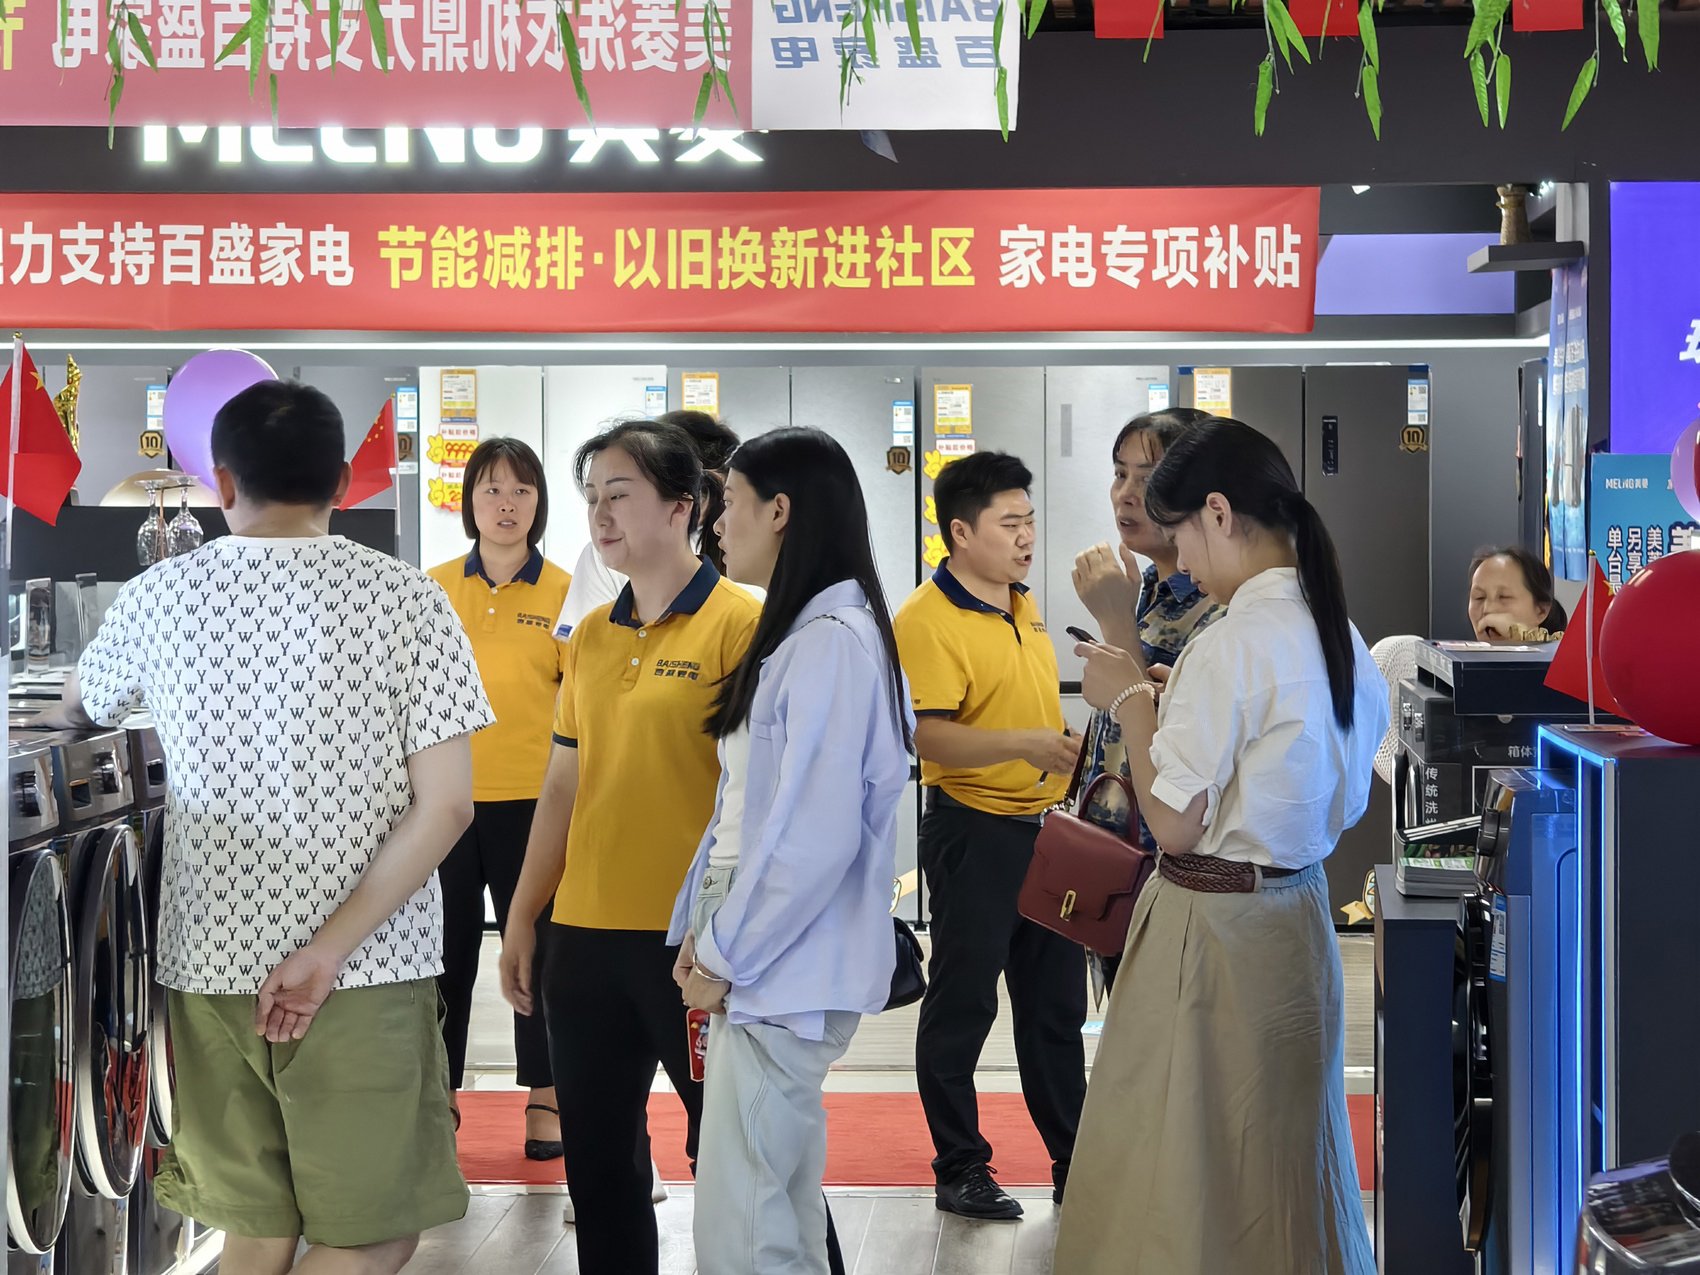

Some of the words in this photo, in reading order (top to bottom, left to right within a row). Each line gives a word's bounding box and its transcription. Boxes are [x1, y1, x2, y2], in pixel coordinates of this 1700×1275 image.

[0, 222, 354, 287] 力支持百盛家电
[379, 225, 975, 290] 节能减排·以旧换新进社区
[999, 223, 1302, 289] 家电专项补贴
[145, 436, 158, 448] 10
[1407, 430, 1421, 443] 10
[292, 548, 302, 560] Y
[232, 570, 242, 584] Y
[261, 571, 270, 584] Y
[288, 570, 298, 582] Y
[374, 569, 384, 580] Y
[201, 592, 210, 606] Y
[257, 594, 267, 607] Y
[285, 592, 295, 605] Y
[370, 591, 380, 604] Y
[185, 604, 199, 616] W
[269, 606, 283, 617] W
[353, 602, 368, 614] W
[198, 617, 208, 631] Y
[226, 619, 236, 632] Y
[255, 619, 264, 632] Y
[282, 617, 292, 630] Y
[310, 614, 319, 627] Y
[338, 613, 348, 627] Y
[367, 616, 376, 629] Y
[266, 631, 280, 642] W
[294, 628, 308, 640] W
[321, 626, 336, 637] W
[350, 627, 364, 639] W
[197, 644, 206, 657] Y
[224, 644, 234, 658] Y
[253, 644, 262, 658] Y
[335, 638, 346, 653] Y
[364, 641, 374, 655] Y
[265, 656, 279, 668] W
[292, 654, 306, 666] W
[319, 652, 334, 664] W
[348, 653, 362, 665] W
[224, 670, 234, 684] Y
[279, 668, 288, 682] Y
[306, 666, 316, 681] Y
[334, 666, 344, 680] Y
[362, 667, 372, 681] Y
[209, 684, 224, 695] W
[237, 683, 251, 694] W
[264, 682, 278, 694] W
[290, 681, 305, 692] W
[318, 680, 334, 692] W
[347, 680, 362, 692] W
[375, 681, 388, 694] W
[224, 696, 234, 710] Y
[278, 694, 287, 709] Y
[305, 693, 315, 708] Y
[334, 693, 344, 707] Y
[362, 693, 372, 707] Y
[264, 709, 277, 720] W
[290, 708, 304, 719] W
[318, 707, 334, 718] W
[347, 706, 361, 718] W
[198, 722, 208, 736] Y
[226, 722, 235, 736] Y
[305, 720, 316, 734] Y
[239, 735, 253, 747] W
[319, 734, 334, 746] W
[199, 749, 209, 762] Y
[306, 747, 316, 760] Y
[335, 746, 345, 760] Y
[240, 761, 254, 773] W
[292, 760, 306, 772] W
[320, 760, 335, 772] W
[349, 759, 363, 770] W
[228, 774, 237, 788] Y
[255, 773, 264, 787] Y
[308, 772, 317, 786] Y
[336, 772, 346, 786] Y
[212, 788, 227, 799] W
[240, 787, 254, 798] W
[292, 786, 308, 798] W
[321, 786, 336, 798] W
[349, 785, 363, 796] W
[227, 800, 238, 814] Y
[255, 799, 264, 813] Y
[308, 798, 318, 812] Y
[336, 798, 346, 813] Y
[213, 814, 226, 825] W
[241, 813, 255, 824] W
[267, 812, 282, 823] W
[294, 812, 308, 824] W
[348, 810, 363, 822] W
[227, 826, 238, 840] Y
[308, 824, 318, 839] Y
[336, 824, 346, 838] Y
[364, 822, 373, 836] Y
[214, 839, 227, 851] W
[240, 838, 255, 850] W
[268, 838, 282, 849] W
[295, 838, 308, 849] W
[322, 838, 336, 849] W
[350, 836, 363, 849] W
[228, 851, 237, 865] Y
[255, 850, 265, 864] Y
[282, 850, 292, 864] Y
[214, 865, 227, 876] W
[240, 864, 255, 876] W
[268, 863, 282, 874] W
[322, 864, 336, 875] W
[228, 877, 238, 890] Y
[255, 876, 265, 890] Y
[283, 875, 292, 888] Y
[310, 876, 319, 890] Y
[214, 890, 228, 902] W
[240, 889, 255, 901] W
[268, 888, 282, 900] W
[295, 888, 310, 900] W
[228, 902, 238, 916] Y
[255, 901, 265, 915] Y
[282, 900, 292, 914] Y
[310, 901, 320, 915] Y
[240, 914, 255, 926] W
[267, 914, 282, 926] W
[228, 927, 238, 941] Y
[254, 926, 264, 940] Y
[281, 926, 291, 940] Y
[240, 940, 254, 951] W
[266, 939, 280, 950] W
[227, 952, 237, 966] Y
[253, 952, 263, 965] Y
[239, 964, 253, 976] W
